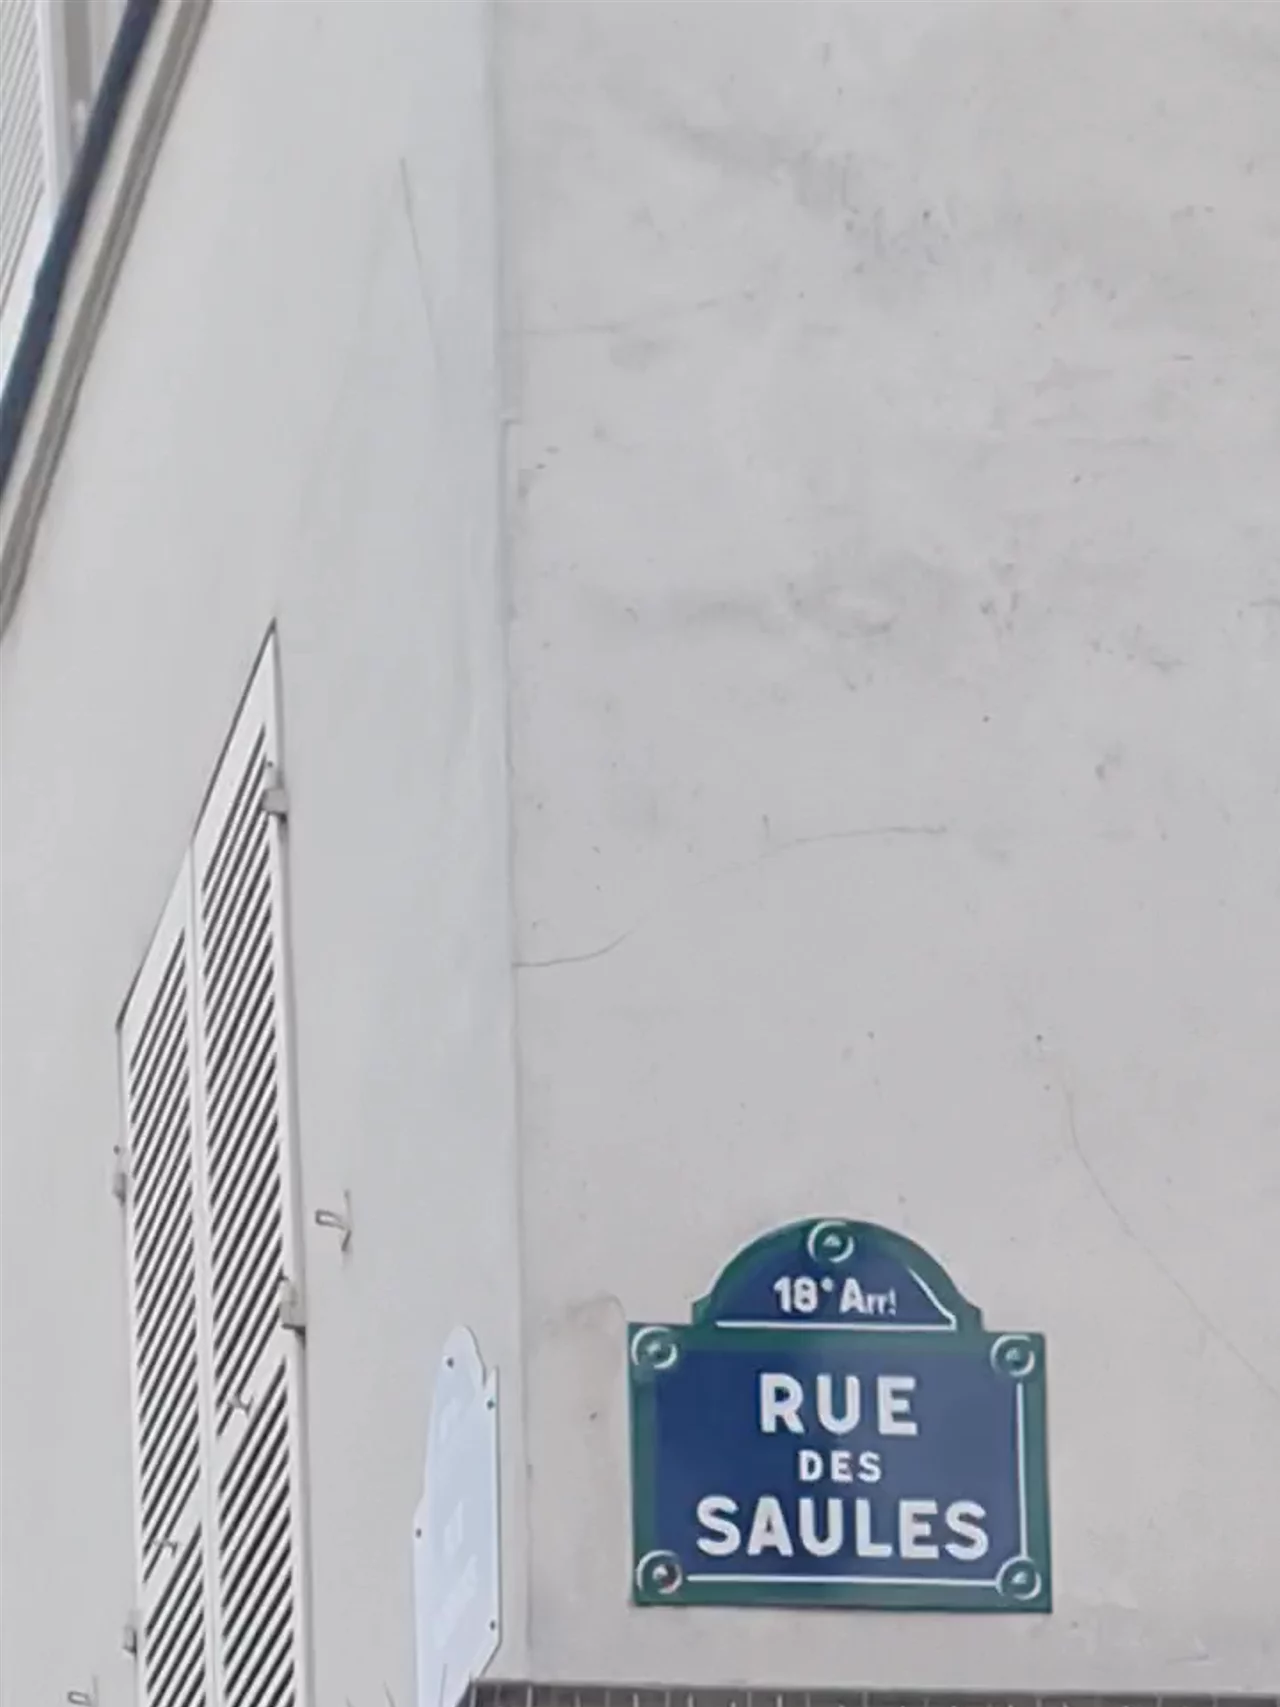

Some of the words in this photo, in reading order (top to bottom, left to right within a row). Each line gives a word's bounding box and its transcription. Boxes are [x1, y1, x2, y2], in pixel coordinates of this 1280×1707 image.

[759, 1373, 917, 1435] RUE
[799, 1449, 882, 1483] DES
[696, 1495, 988, 1560] SAULES
